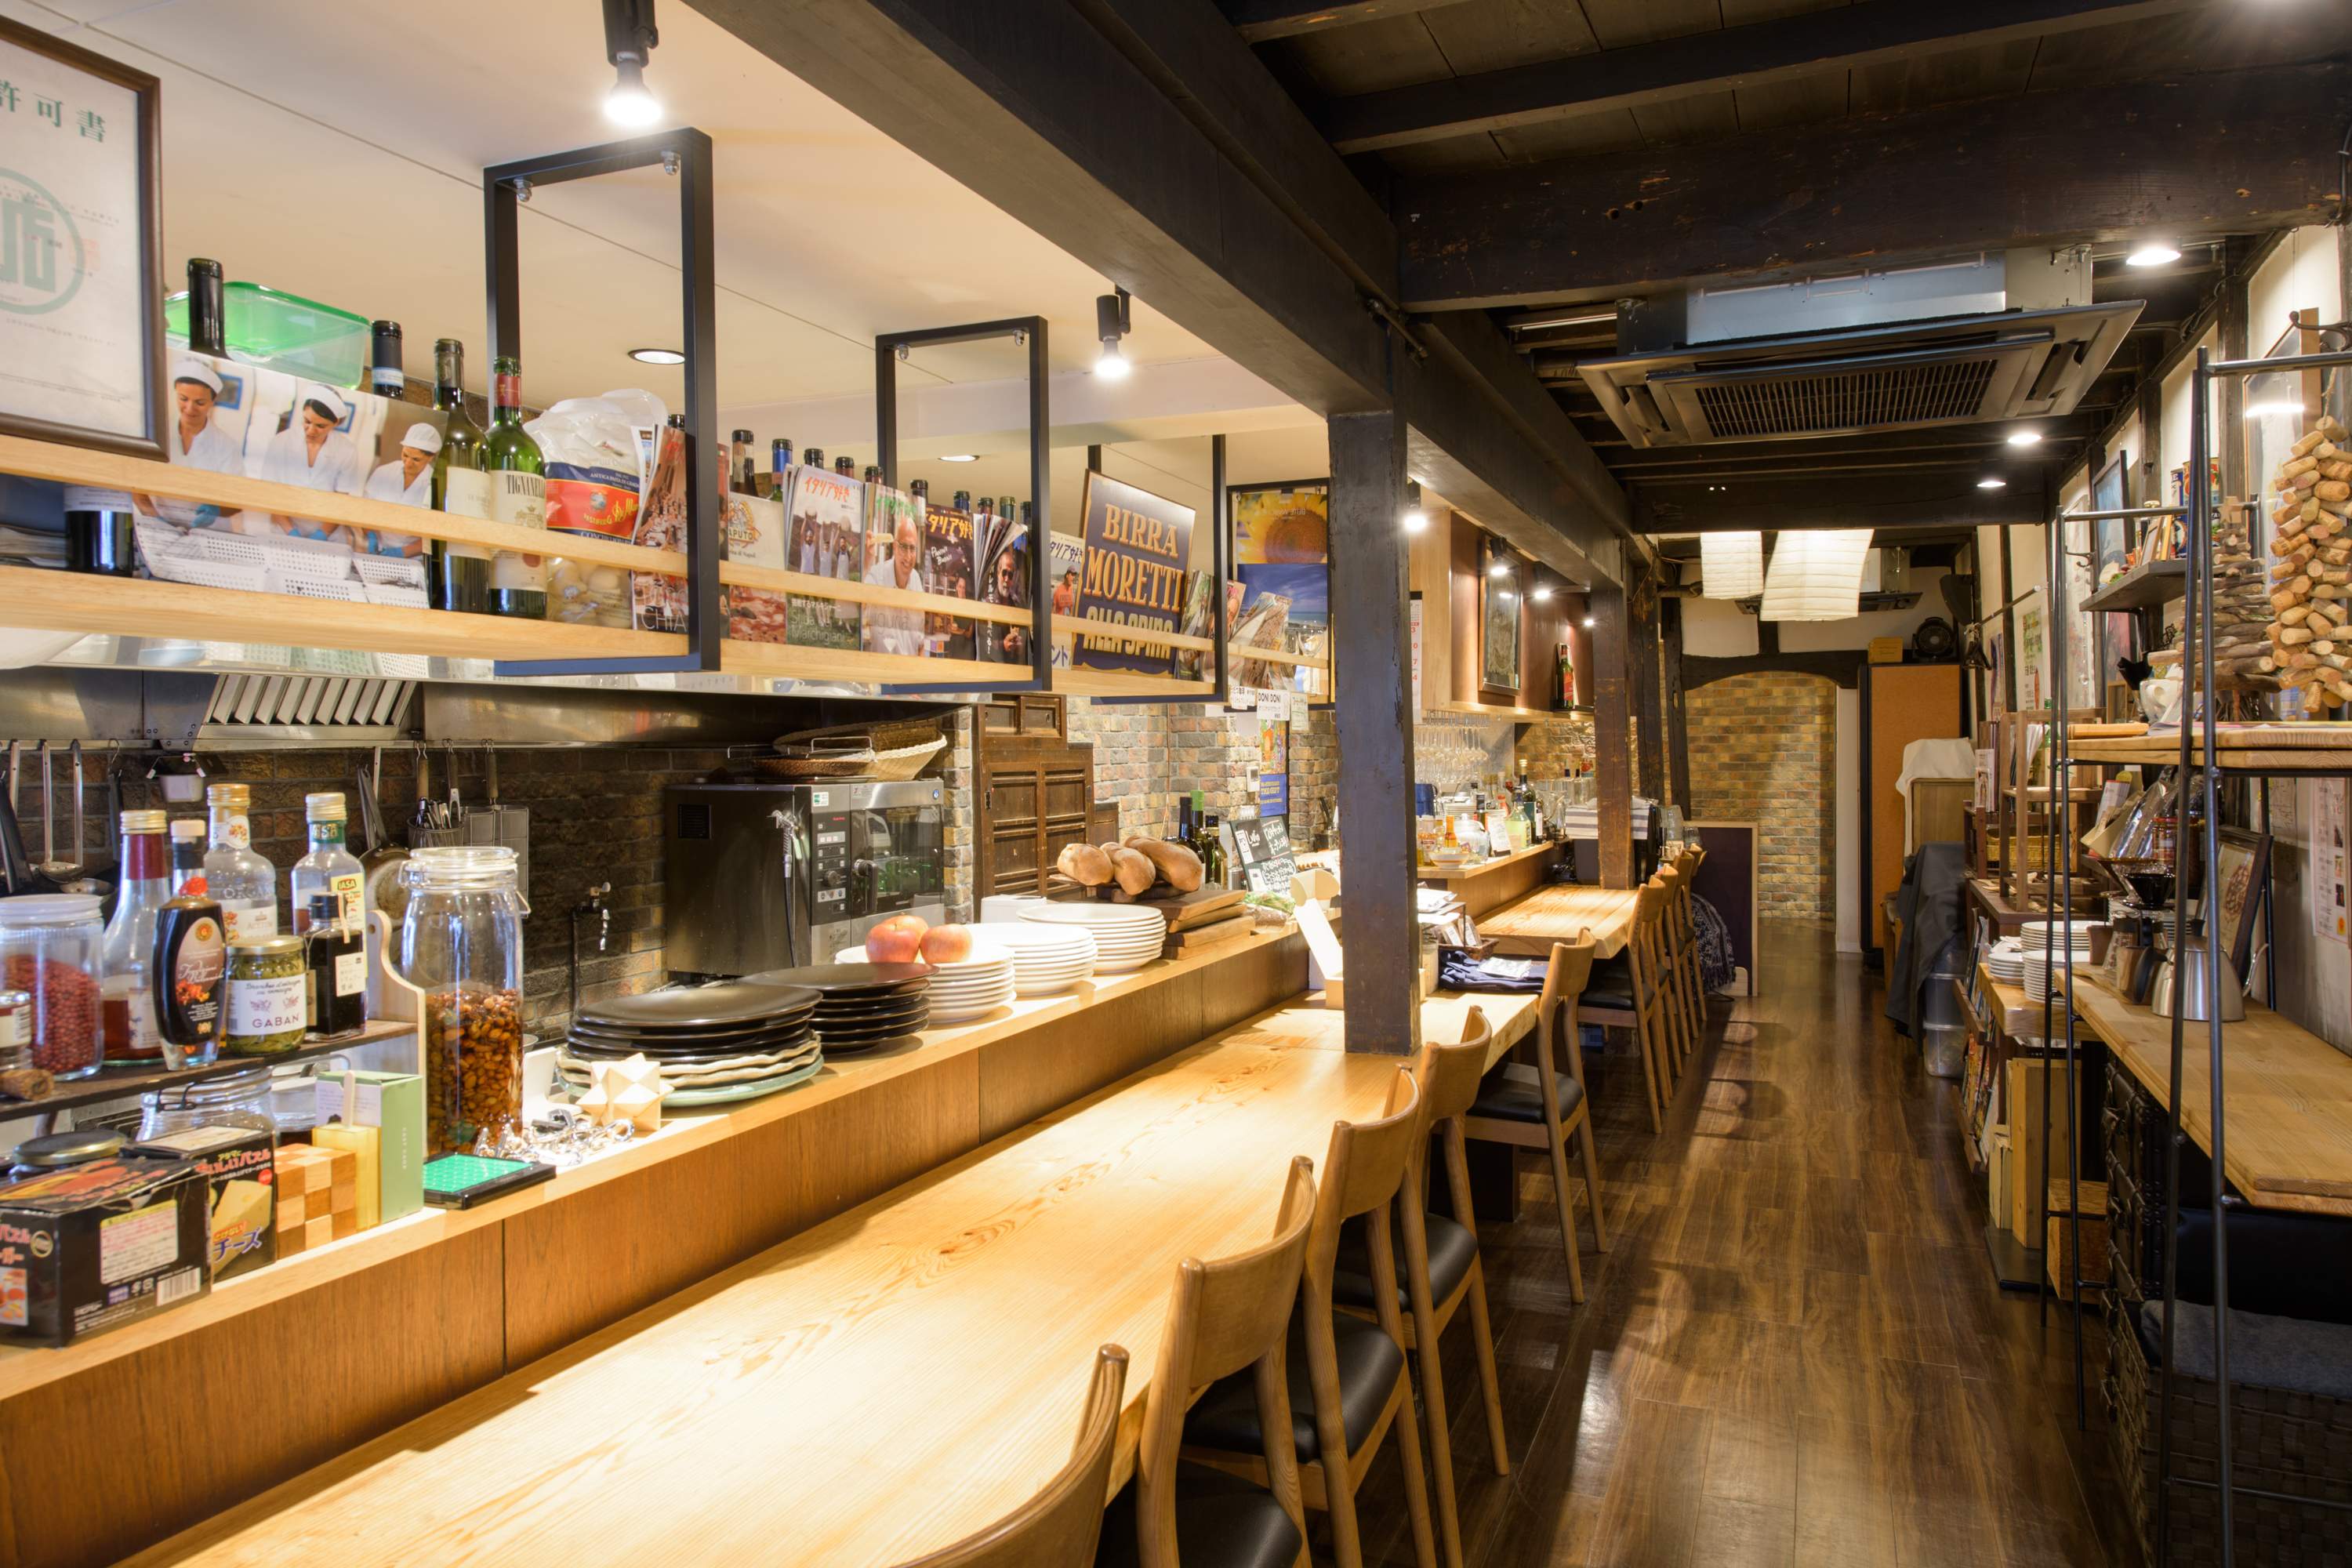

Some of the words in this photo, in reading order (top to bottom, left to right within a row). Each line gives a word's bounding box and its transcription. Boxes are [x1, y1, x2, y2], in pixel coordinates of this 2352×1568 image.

[804, 476, 850, 503] イタリア好き
[876, 495, 918, 521] イタリア好き
[926, 513, 973, 540] タリア好き
[1102, 503, 1178, 559] BIRRA
[1083, 546, 1185, 612] MORETTI
[641, 606, 687, 632] CHIA
[791, 609, 815, 626] Sfida
[866, 610, 909, 635] Liguria
[791, 625, 845, 645] Marchigiani
[1258, 692, 1270, 702] DONI
[1270, 693, 1282, 703] DONI
[339, 880, 355, 890] IASA
[247, 920, 273, 931] ACETUM
[252, 1014, 299, 1029] GABAN
[212, 1226, 263, 1262] チーズ
